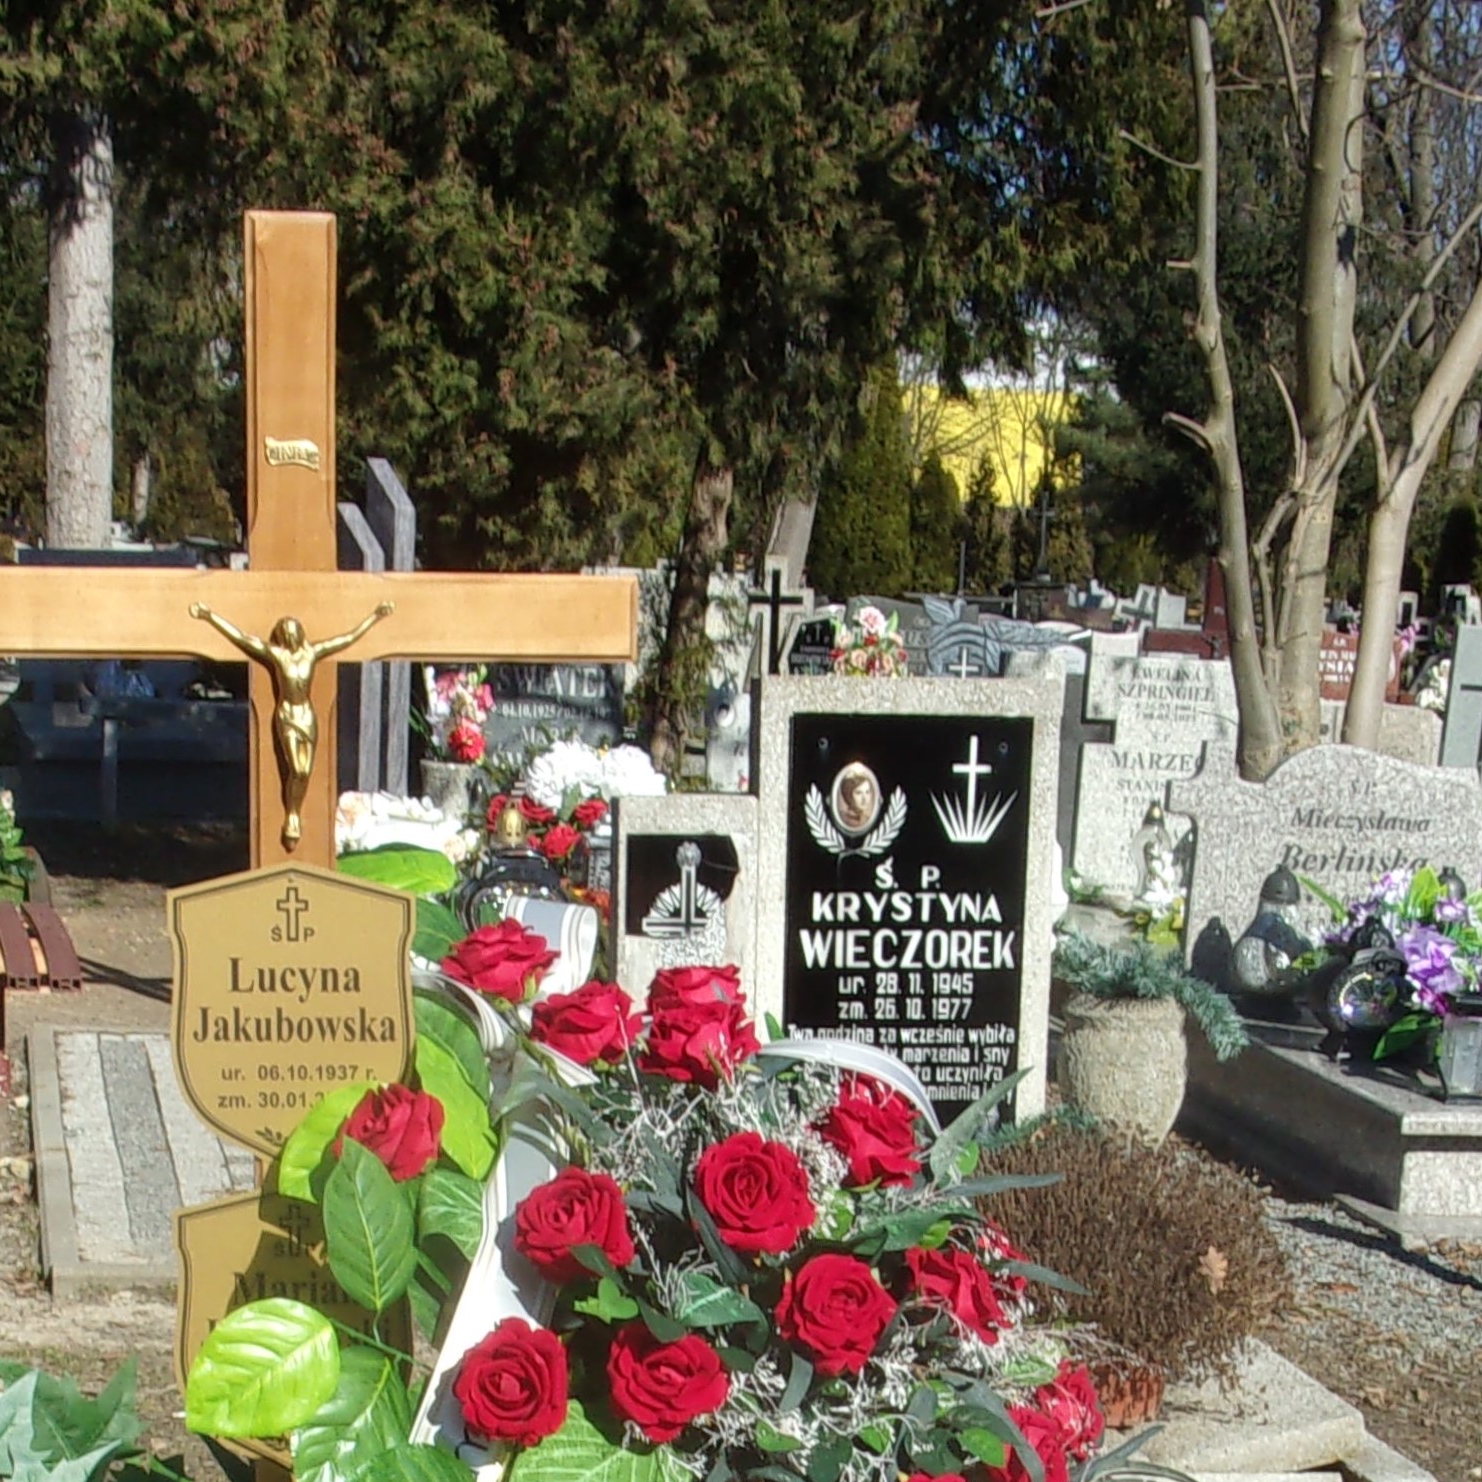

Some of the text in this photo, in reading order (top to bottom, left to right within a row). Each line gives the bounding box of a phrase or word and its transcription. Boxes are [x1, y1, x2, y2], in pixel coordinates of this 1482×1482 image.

[811, 890, 1003, 924] KRYSTYNA
[303, 926, 315, 943] P
[799, 927, 1016, 971] WIECZOREK
[228, 956, 362, 1003] Lucyna
[838, 975, 866, 995] ur.
[875, 971, 902, 995] 28.
[932, 971, 974, 995] 1945
[837, 997, 973, 1020] zm. 26. 10. 1977
[192, 1006, 397, 1043] Jakubowska
[878, 1027, 897, 1043] za
[900, 1024, 965, 1044] wcześnie
[968, 1024, 1016, 1046] wybiła
[902, 1047, 969, 1063] marzenia
[983, 1048, 1011, 1066] sny
[221, 1064, 377, 1082] ur. 06.10.1937 r.
[935, 1064, 1004, 1085] uczyniła
[218, 1091, 325, 1109] zm. 30.01.2
